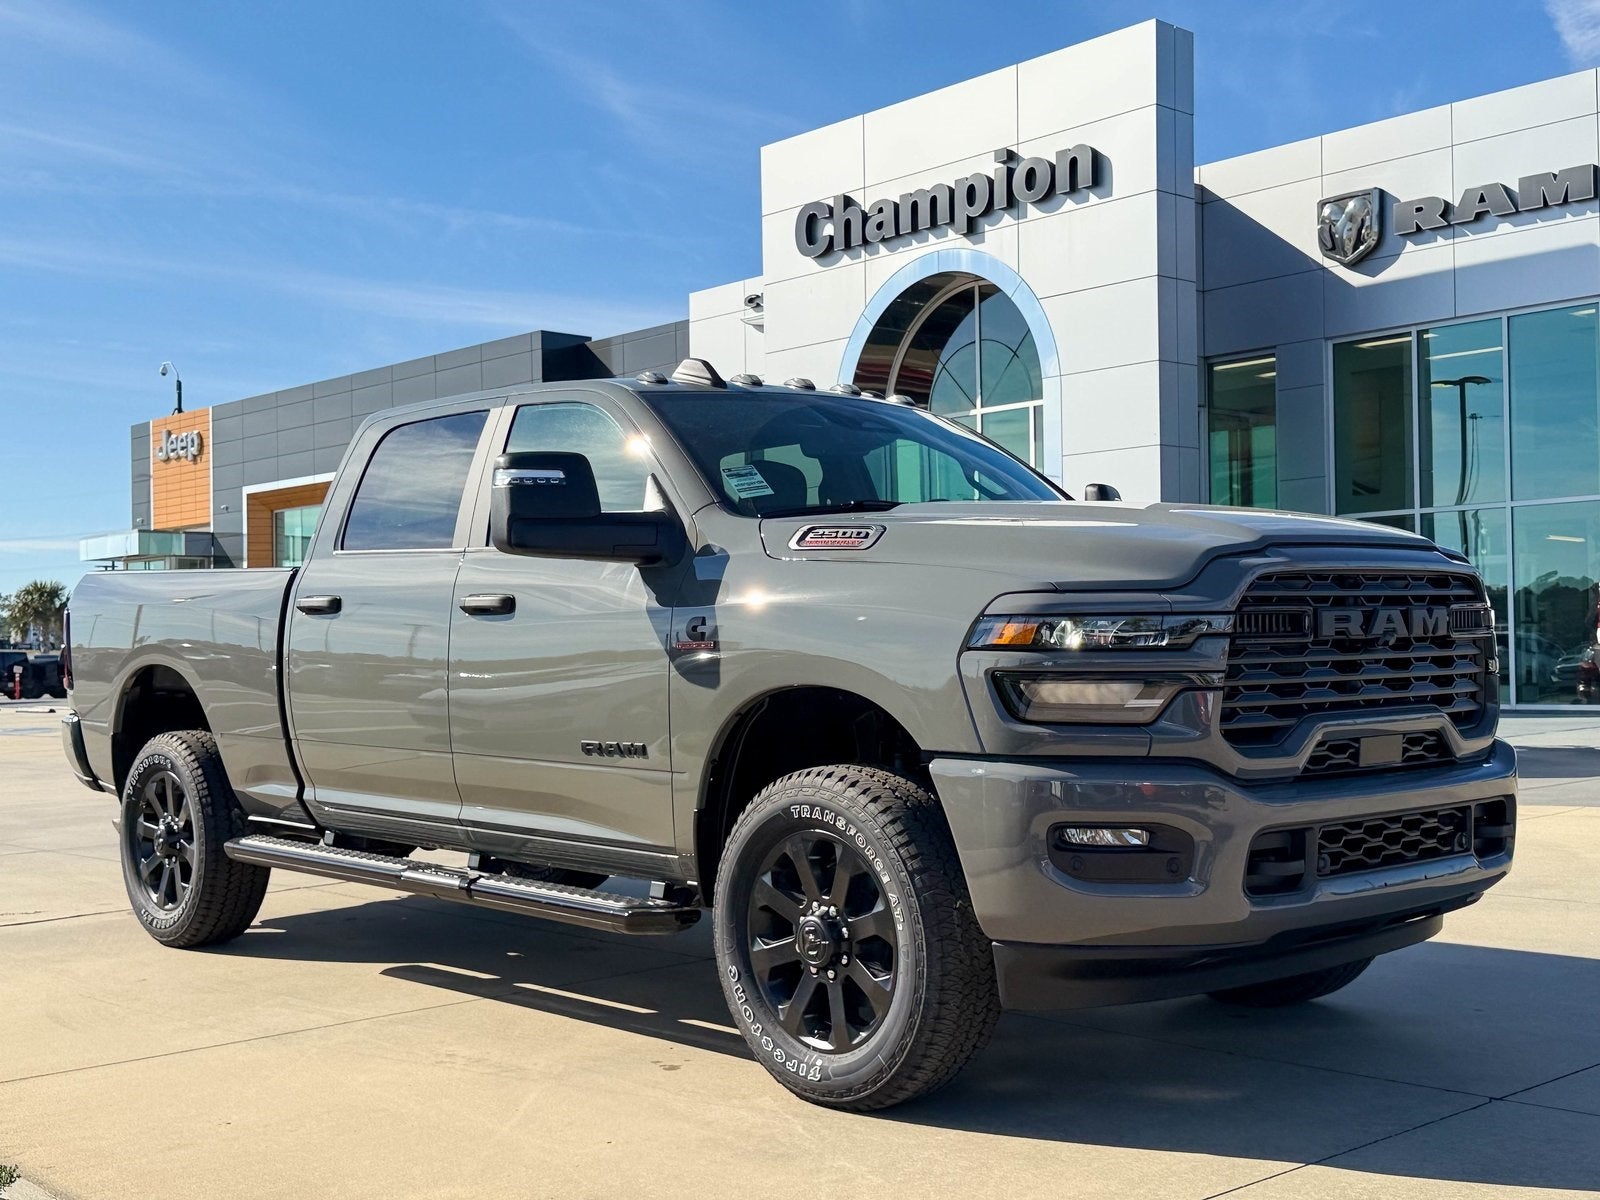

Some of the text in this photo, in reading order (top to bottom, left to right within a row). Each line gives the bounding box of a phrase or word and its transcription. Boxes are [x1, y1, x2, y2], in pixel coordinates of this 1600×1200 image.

[795, 144, 1100, 258] Champion
[1393, 164, 1596, 236] RAM
[157, 430, 201, 462] Jeep
[810, 530, 870, 539] 2500
[1320, 607, 1448, 638] RAM
[581, 740, 648, 759] RAM
[791, 805, 891, 884] TRANSFORCE
[728, 965, 821, 1081] Firestone
